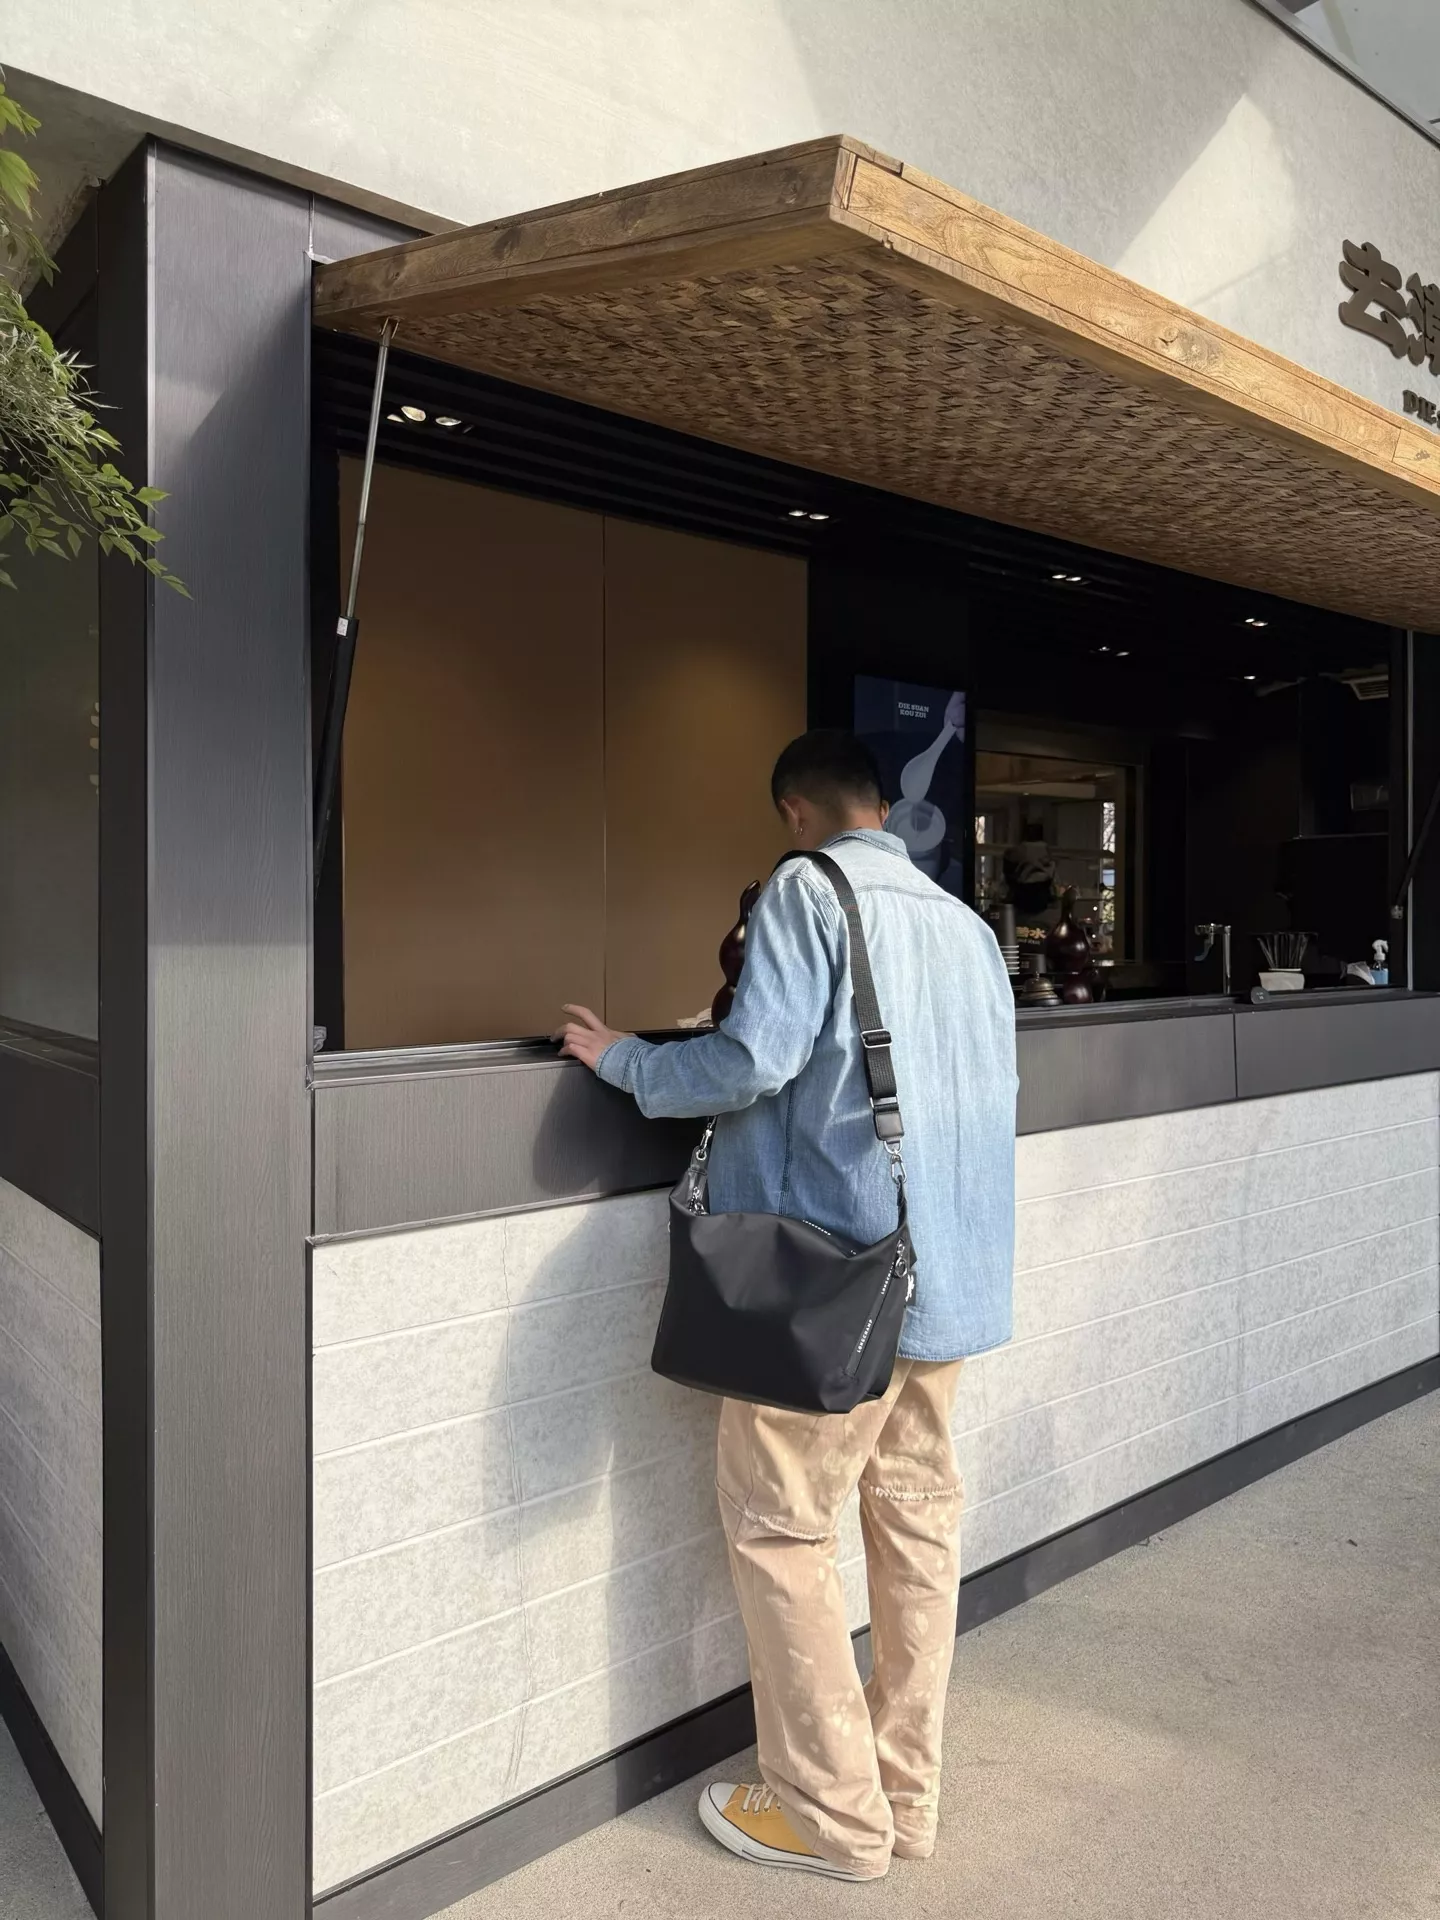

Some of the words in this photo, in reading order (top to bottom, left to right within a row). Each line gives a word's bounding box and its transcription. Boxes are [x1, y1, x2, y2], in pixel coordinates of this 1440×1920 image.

[1402, 389, 1437, 425] DIE
[898, 702, 911, 710] DIE
[856, 1319, 873, 1353] LONGCHAMP
